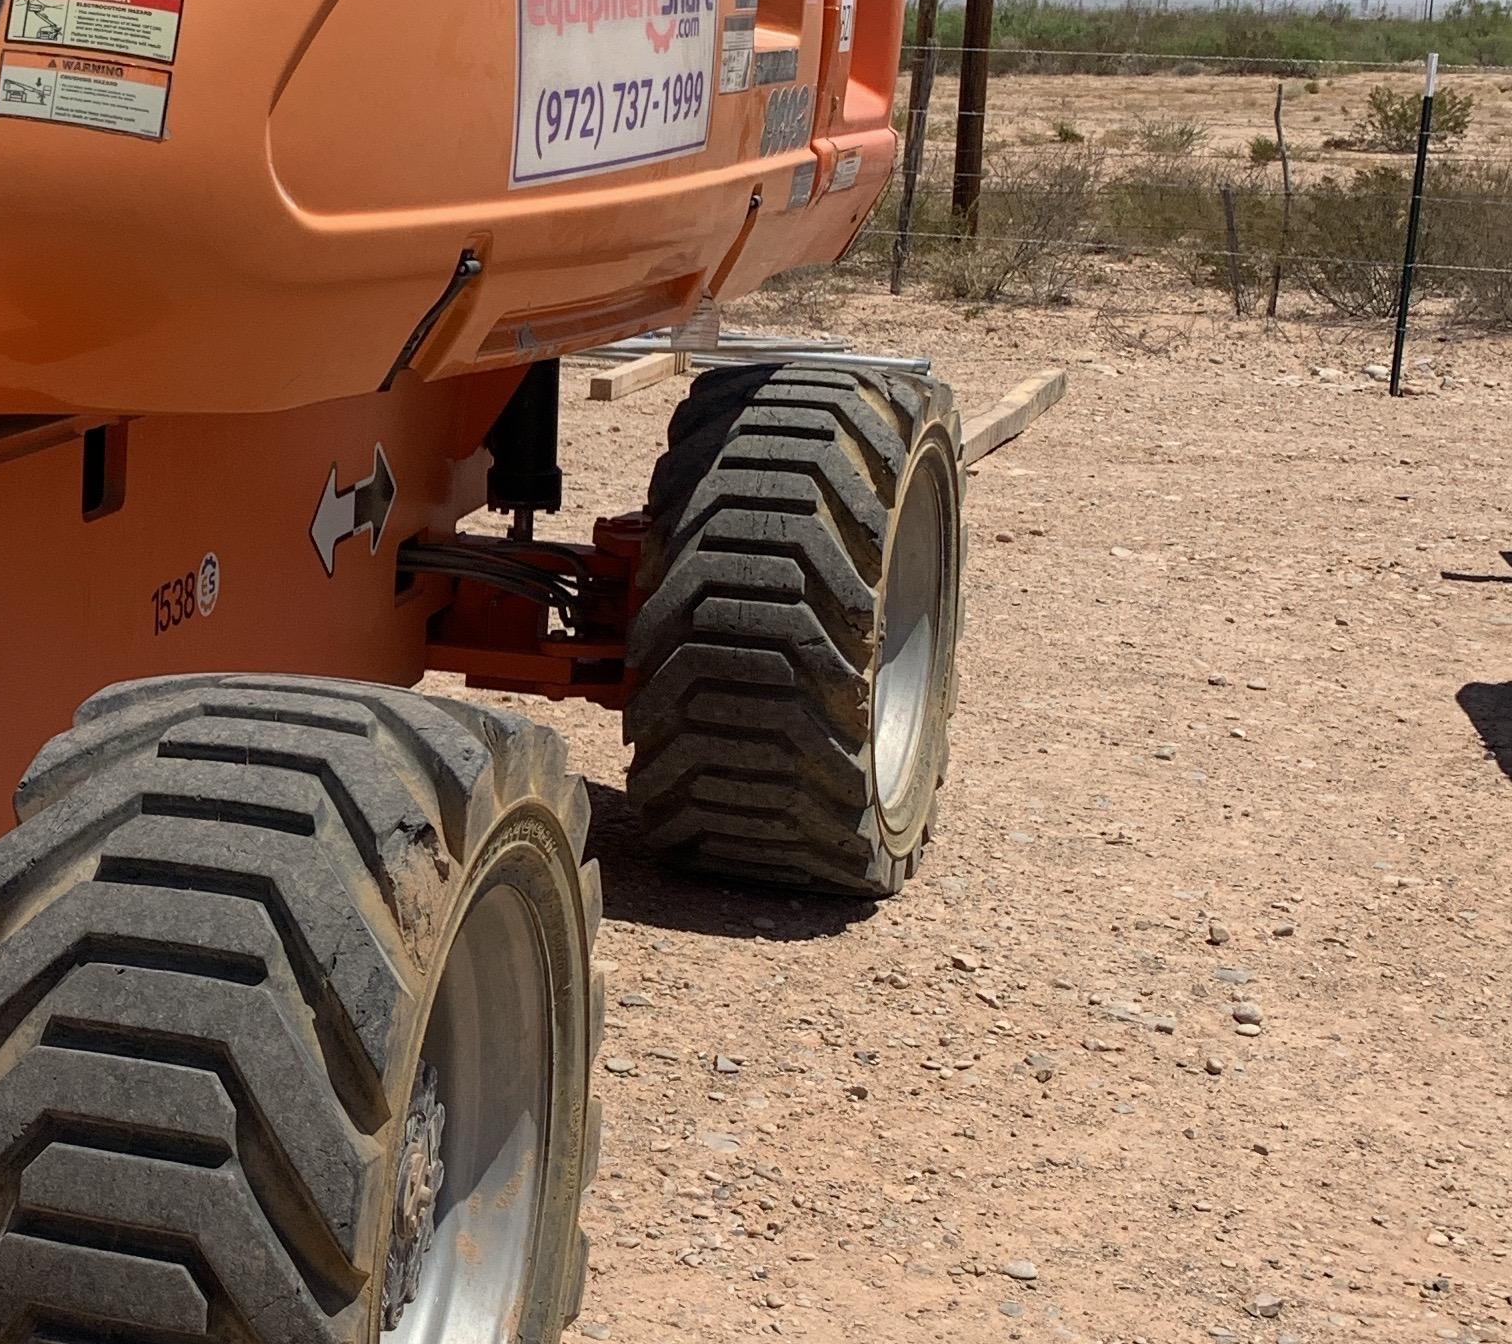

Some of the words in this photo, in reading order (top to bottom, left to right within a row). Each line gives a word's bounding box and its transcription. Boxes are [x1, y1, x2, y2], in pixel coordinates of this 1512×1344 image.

[675, 16, 701, 39] .com
[62, 59, 124, 77] WARNING
[535, 87, 605, 160] (972)
[612, 71, 705, 134] 737-1999
[152, 571, 196, 636] 1538
